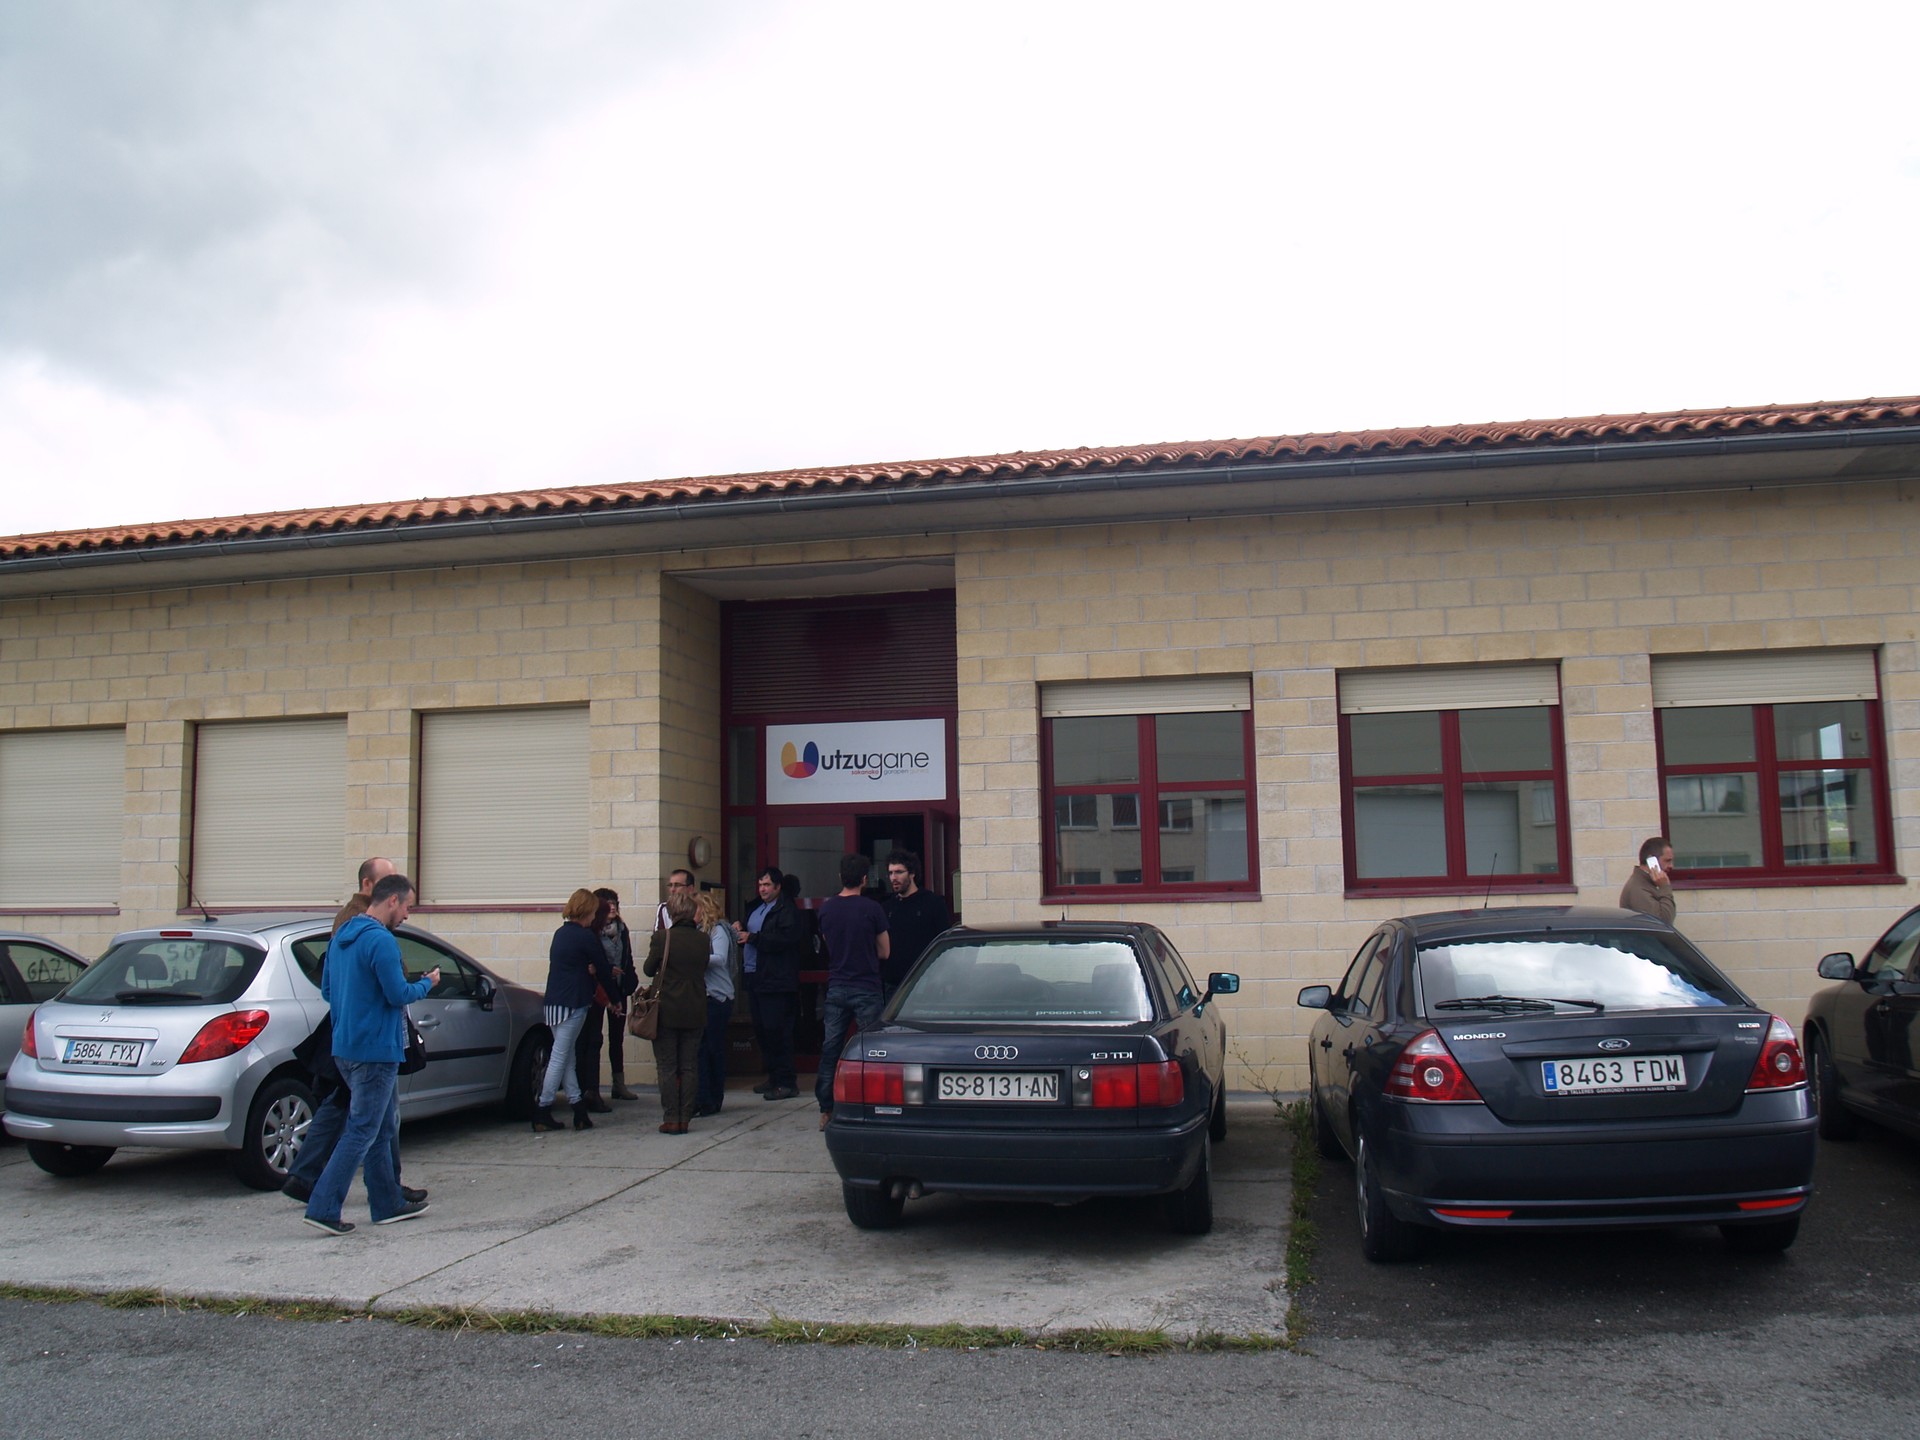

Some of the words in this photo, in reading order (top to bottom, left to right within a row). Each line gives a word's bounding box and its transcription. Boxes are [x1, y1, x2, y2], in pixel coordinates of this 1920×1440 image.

[821, 749, 929, 780] utzugane
[1453, 1032, 1507, 1041] MONDEO
[74, 1042, 104, 1059] 5864
[110, 1044, 137, 1060] FYX
[1110, 1051, 1133, 1060] TDI
[1560, 1061, 1624, 1086] 8463
[1633, 1059, 1680, 1083] FDM
